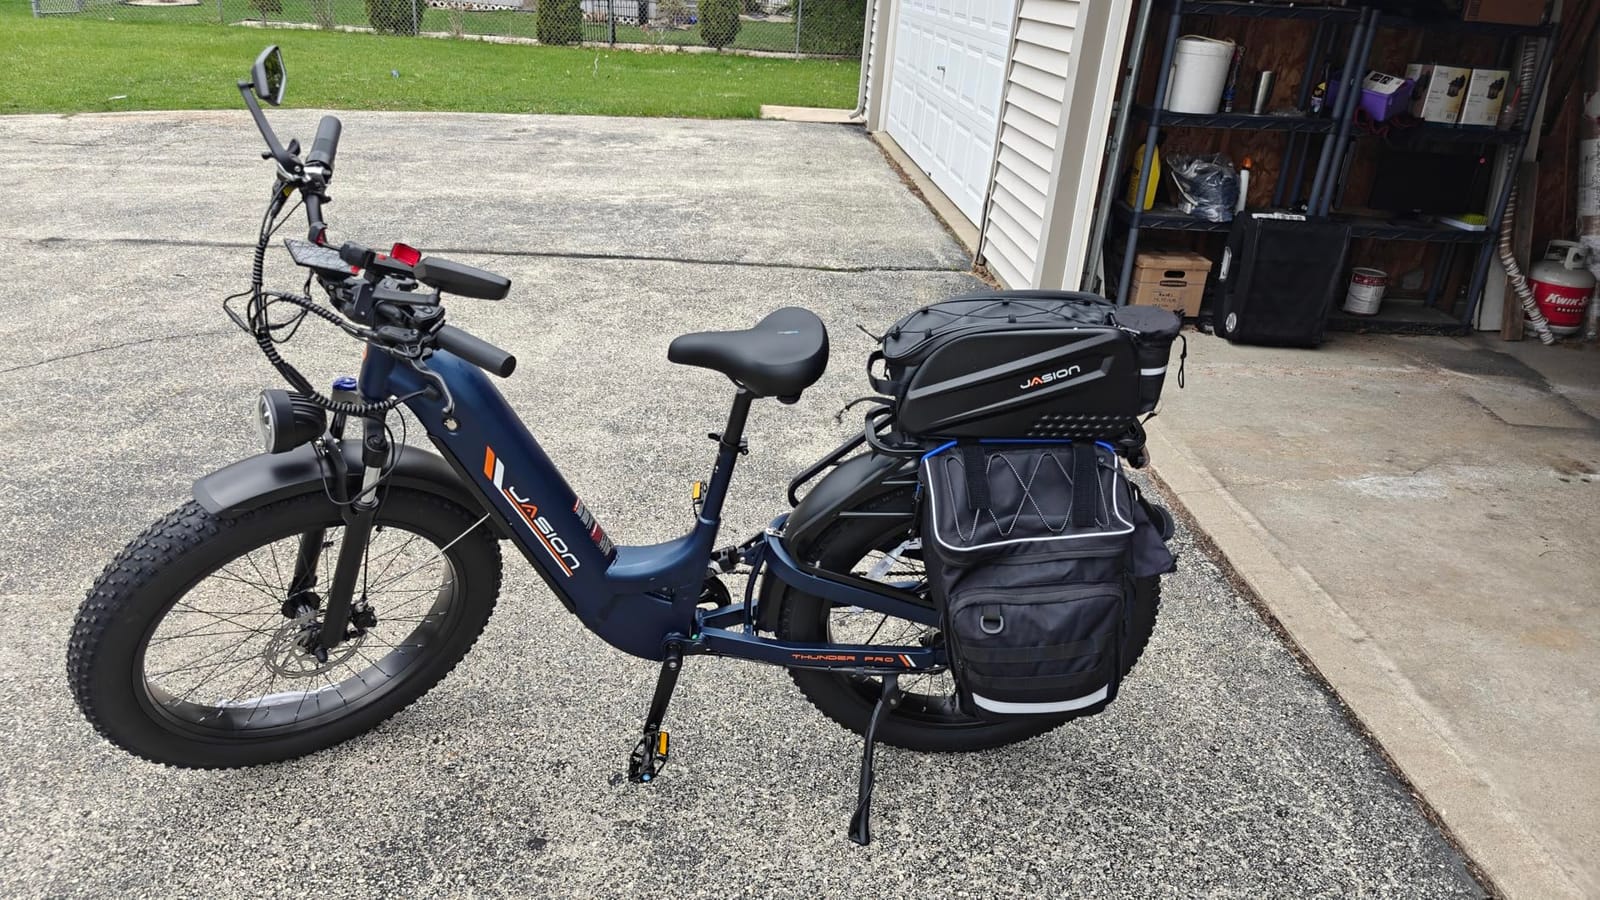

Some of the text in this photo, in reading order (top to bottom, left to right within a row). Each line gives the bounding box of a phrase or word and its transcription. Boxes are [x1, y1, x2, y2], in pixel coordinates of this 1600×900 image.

[1020, 364, 1081, 389] JASION
[509, 486, 580, 569] JASION
[791, 653, 855, 662] THUNDER
